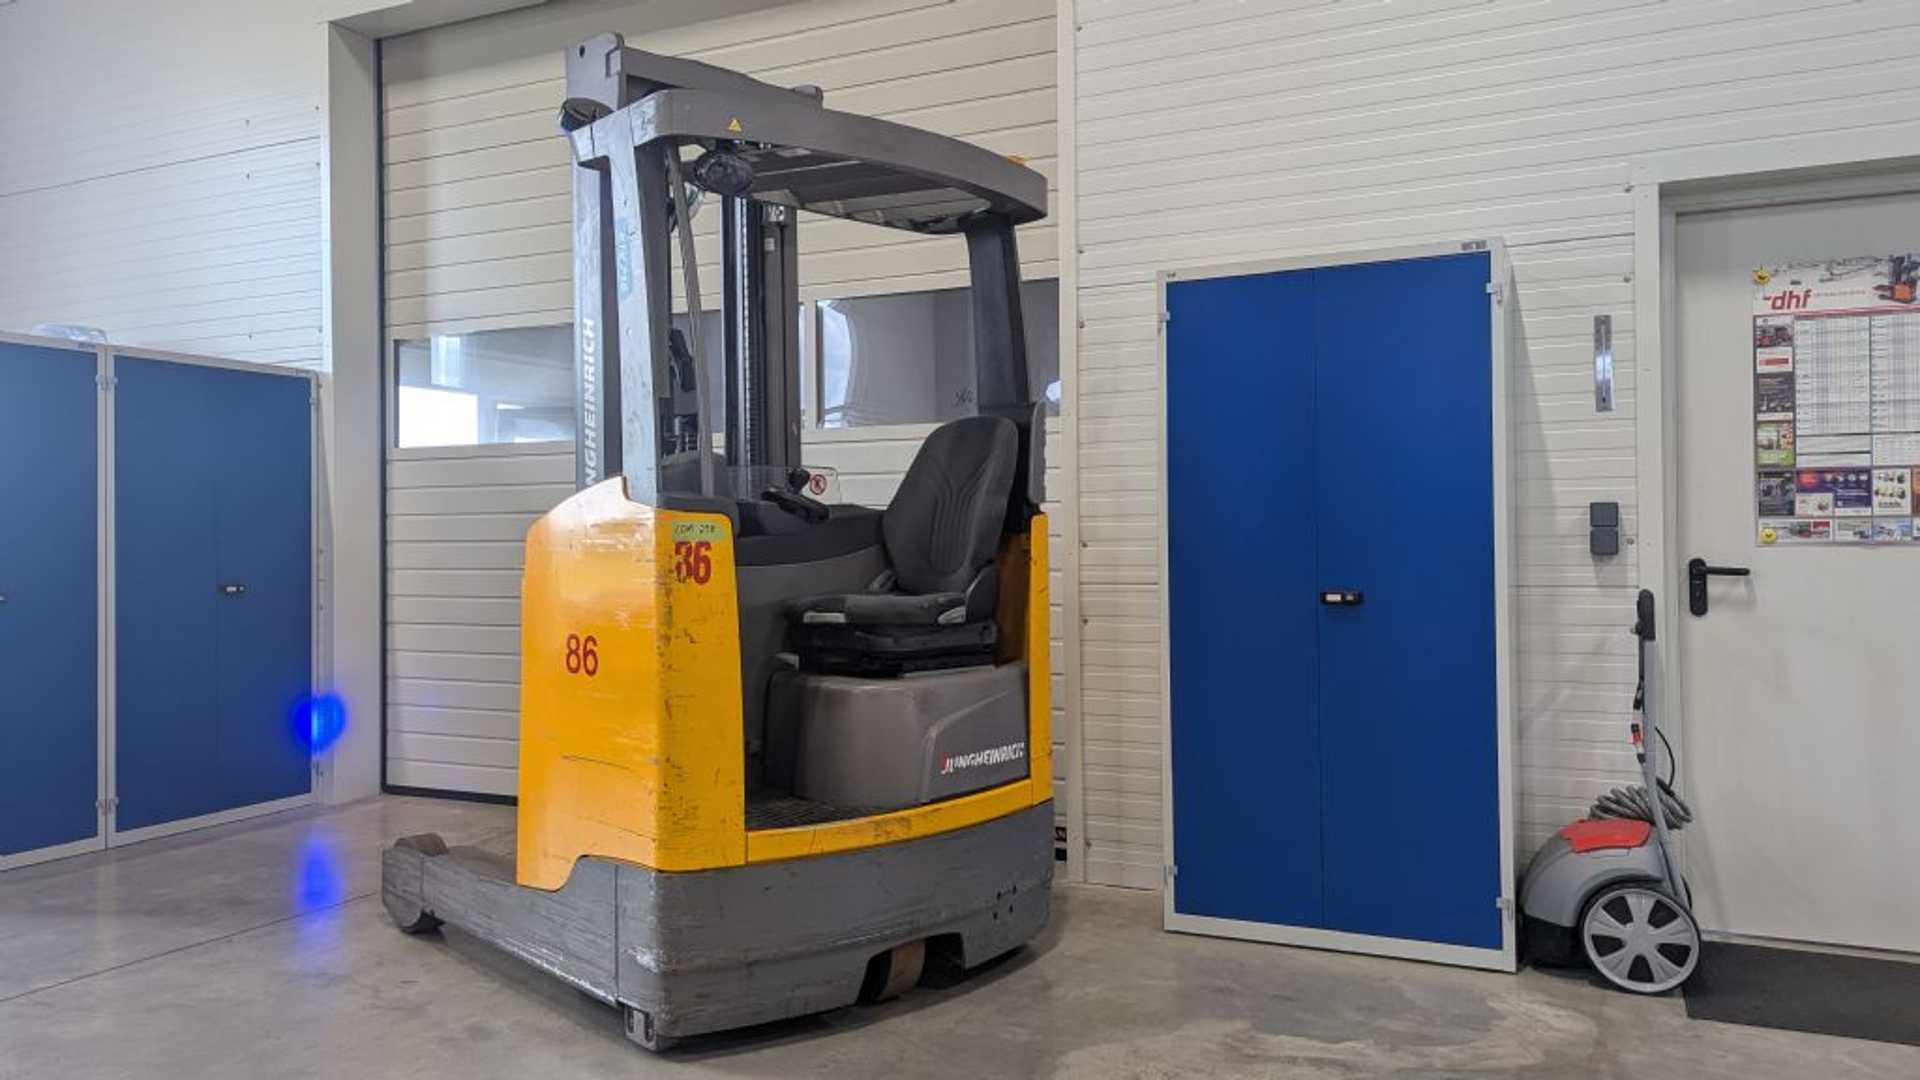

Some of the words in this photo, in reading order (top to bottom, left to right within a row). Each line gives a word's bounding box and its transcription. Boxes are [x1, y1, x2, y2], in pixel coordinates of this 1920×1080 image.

[1771, 289, 1812, 310] dhf
[566, 633, 599, 677] 86
[941, 742, 1025, 775] JUNGHEINRICH
